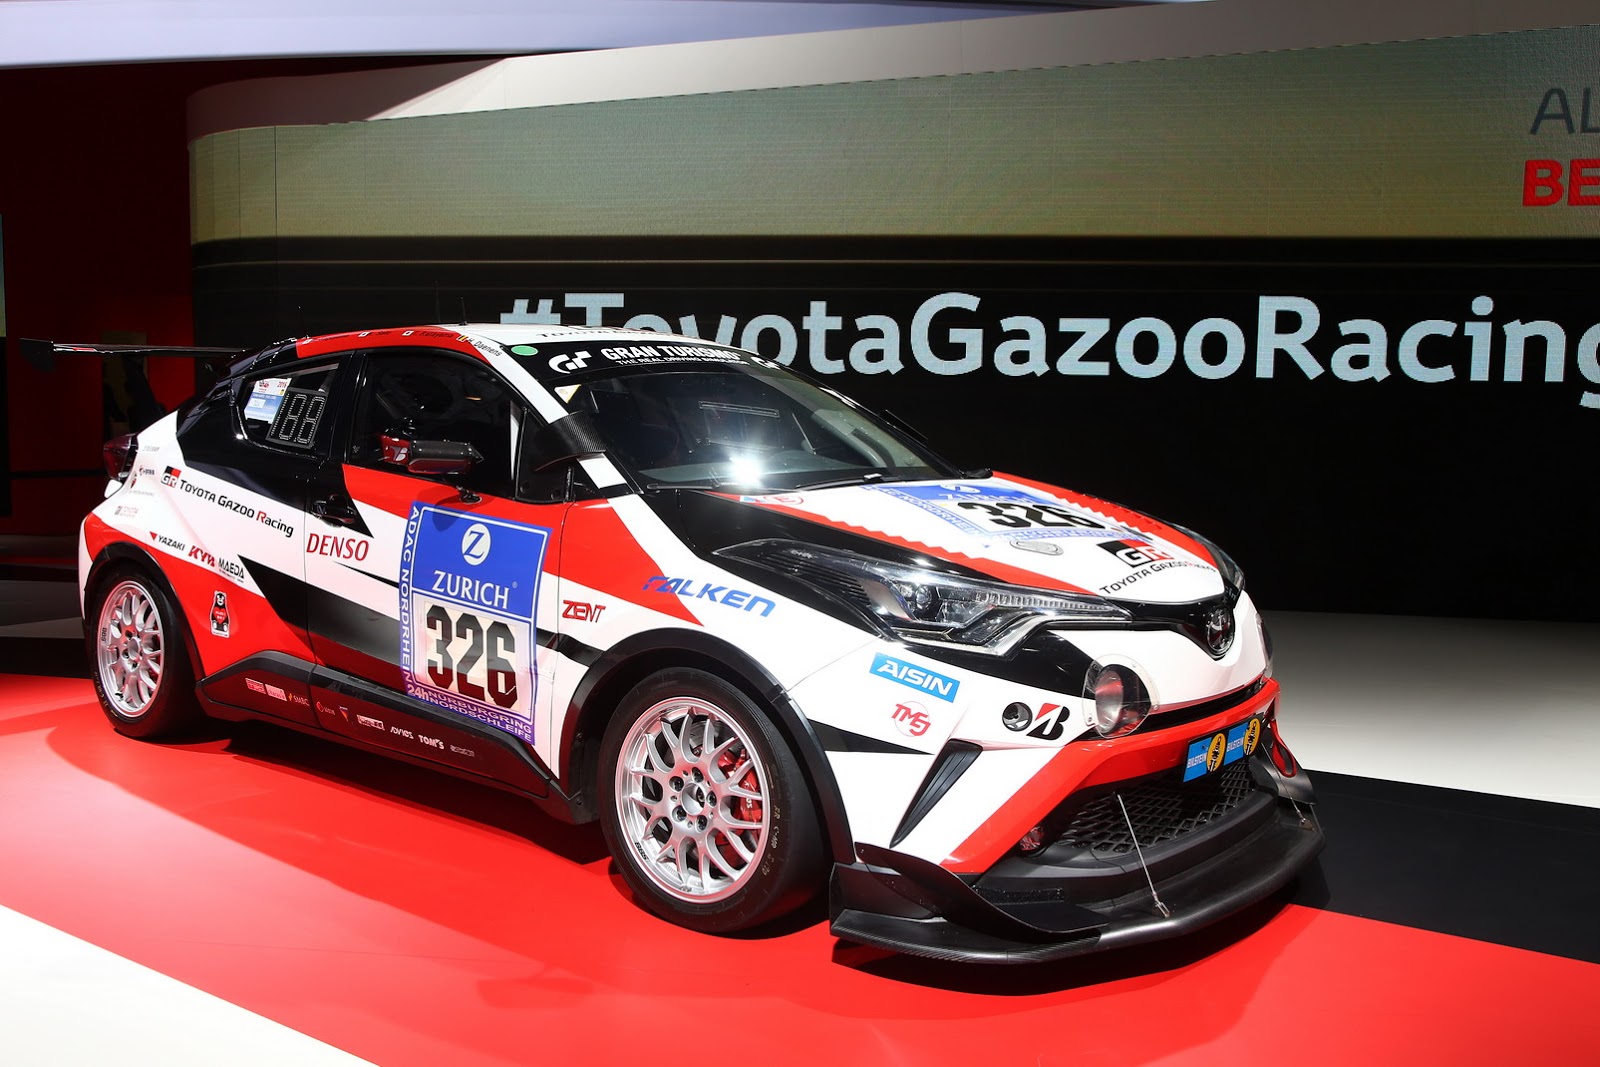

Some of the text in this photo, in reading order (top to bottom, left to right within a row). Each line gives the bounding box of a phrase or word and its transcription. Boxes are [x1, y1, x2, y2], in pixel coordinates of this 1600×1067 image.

[601, 345, 661, 361] GRAN
[657, 345, 741, 361] TURISMO
[615, 358, 637, 367] THE
[638, 357, 664, 366] REAL
[663, 356, 702, 364] DRIVING
[161, 471, 180, 488] GR
[179, 479, 216, 502] TOYOTA
[217, 495, 255, 519] GAZOO
[256, 510, 295, 538] Racing
[957, 502, 1106, 529] 326
[158, 535, 186, 551] YAZAKI
[306, 533, 370, 562] DENSO
[1106, 543, 1174, 568] GR
[217, 557, 245, 579] MAEDA
[1099, 568, 1152, 594] TOYOTA
[400, 506, 419, 683] ADAC NORDRHEIN
[432, 570, 510, 610] ZURICH
[641, 575, 777, 618] FALKEN
[562, 599, 607, 623] ZENT
[426, 604, 518, 709] 326
[877, 659, 953, 697] AISIN
[407, 684, 430, 702] 24h
[428, 697, 532, 742] NORDSCHLEIFE
[891, 703, 931, 737] TMS
[418, 735, 445, 750] TOM'S
[1226, 736, 1246, 753] BILSTEIN
[1187, 752, 1208, 769] BILSTEIN
